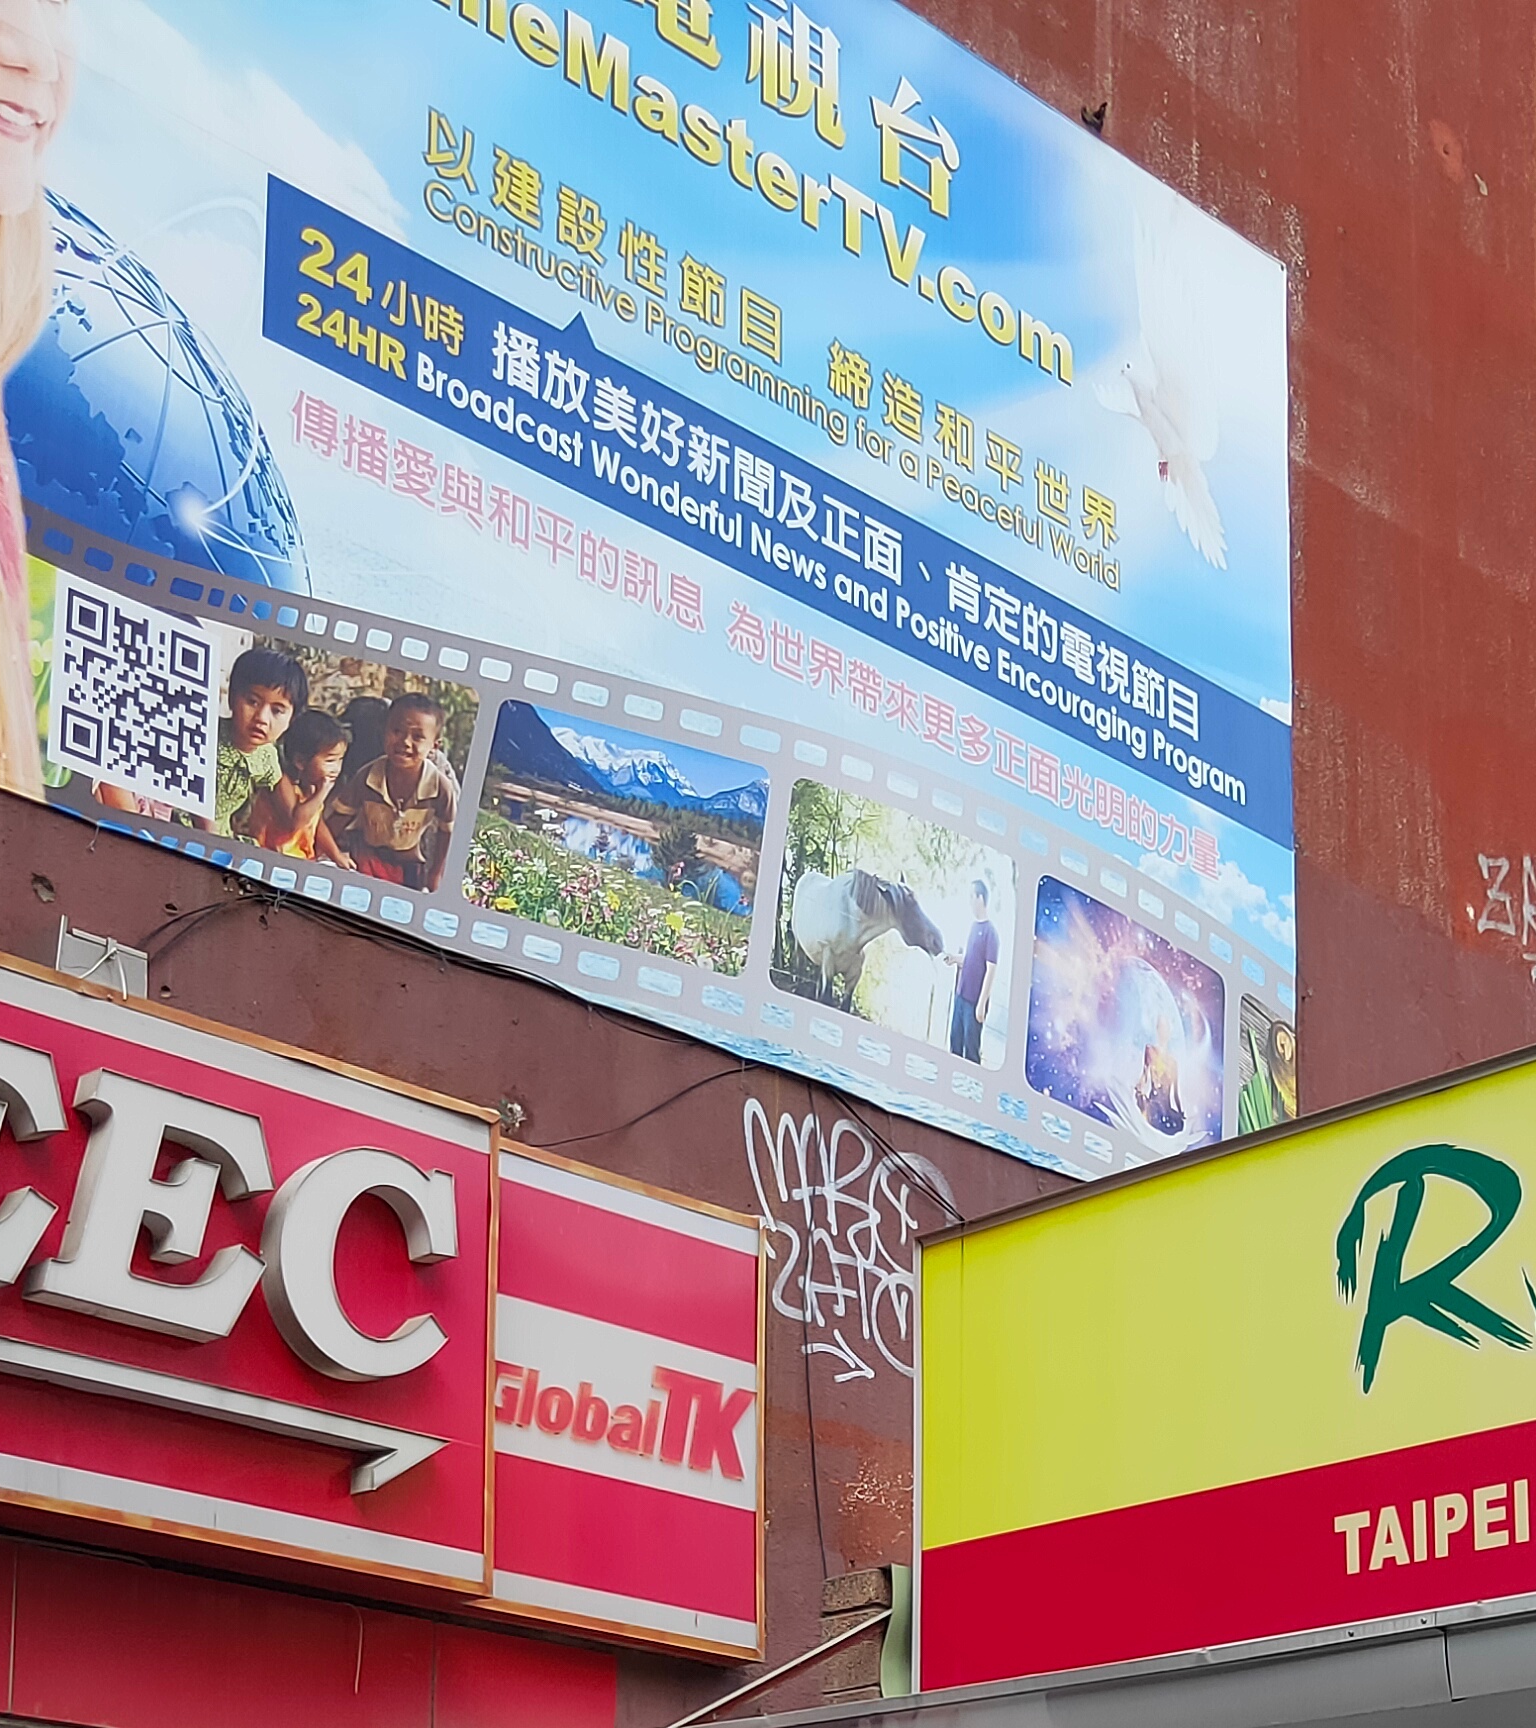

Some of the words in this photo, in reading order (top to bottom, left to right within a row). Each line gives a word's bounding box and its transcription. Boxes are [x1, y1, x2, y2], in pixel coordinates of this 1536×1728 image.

[289, 388, 707, 634] 傳播愛與和平的訊息
[423, 106, 782, 366] 以建設性節目
[827, 339, 1121, 551] 締造和平世界
[423, 180, 638, 323] Constructive
[644, 300, 850, 448] Programming
[855, 416, 896, 468] for
[899, 448, 920, 481] a
[926, 460, 1044, 552] Peaceful
[1046, 524, 1123, 594] World
[296, 292, 408, 381] 24HR
[416, 351, 585, 467] Broadcast
[589, 438, 744, 548] Wonderful
[749, 521, 828, 592] News
[832, 570, 890, 624] and
[894, 594, 993, 673] Positive
[996, 650, 1148, 761] Encouraging
[1152, 740, 1248, 808] Program
[1333, 1478, 1531, 1575] TAIPEI
